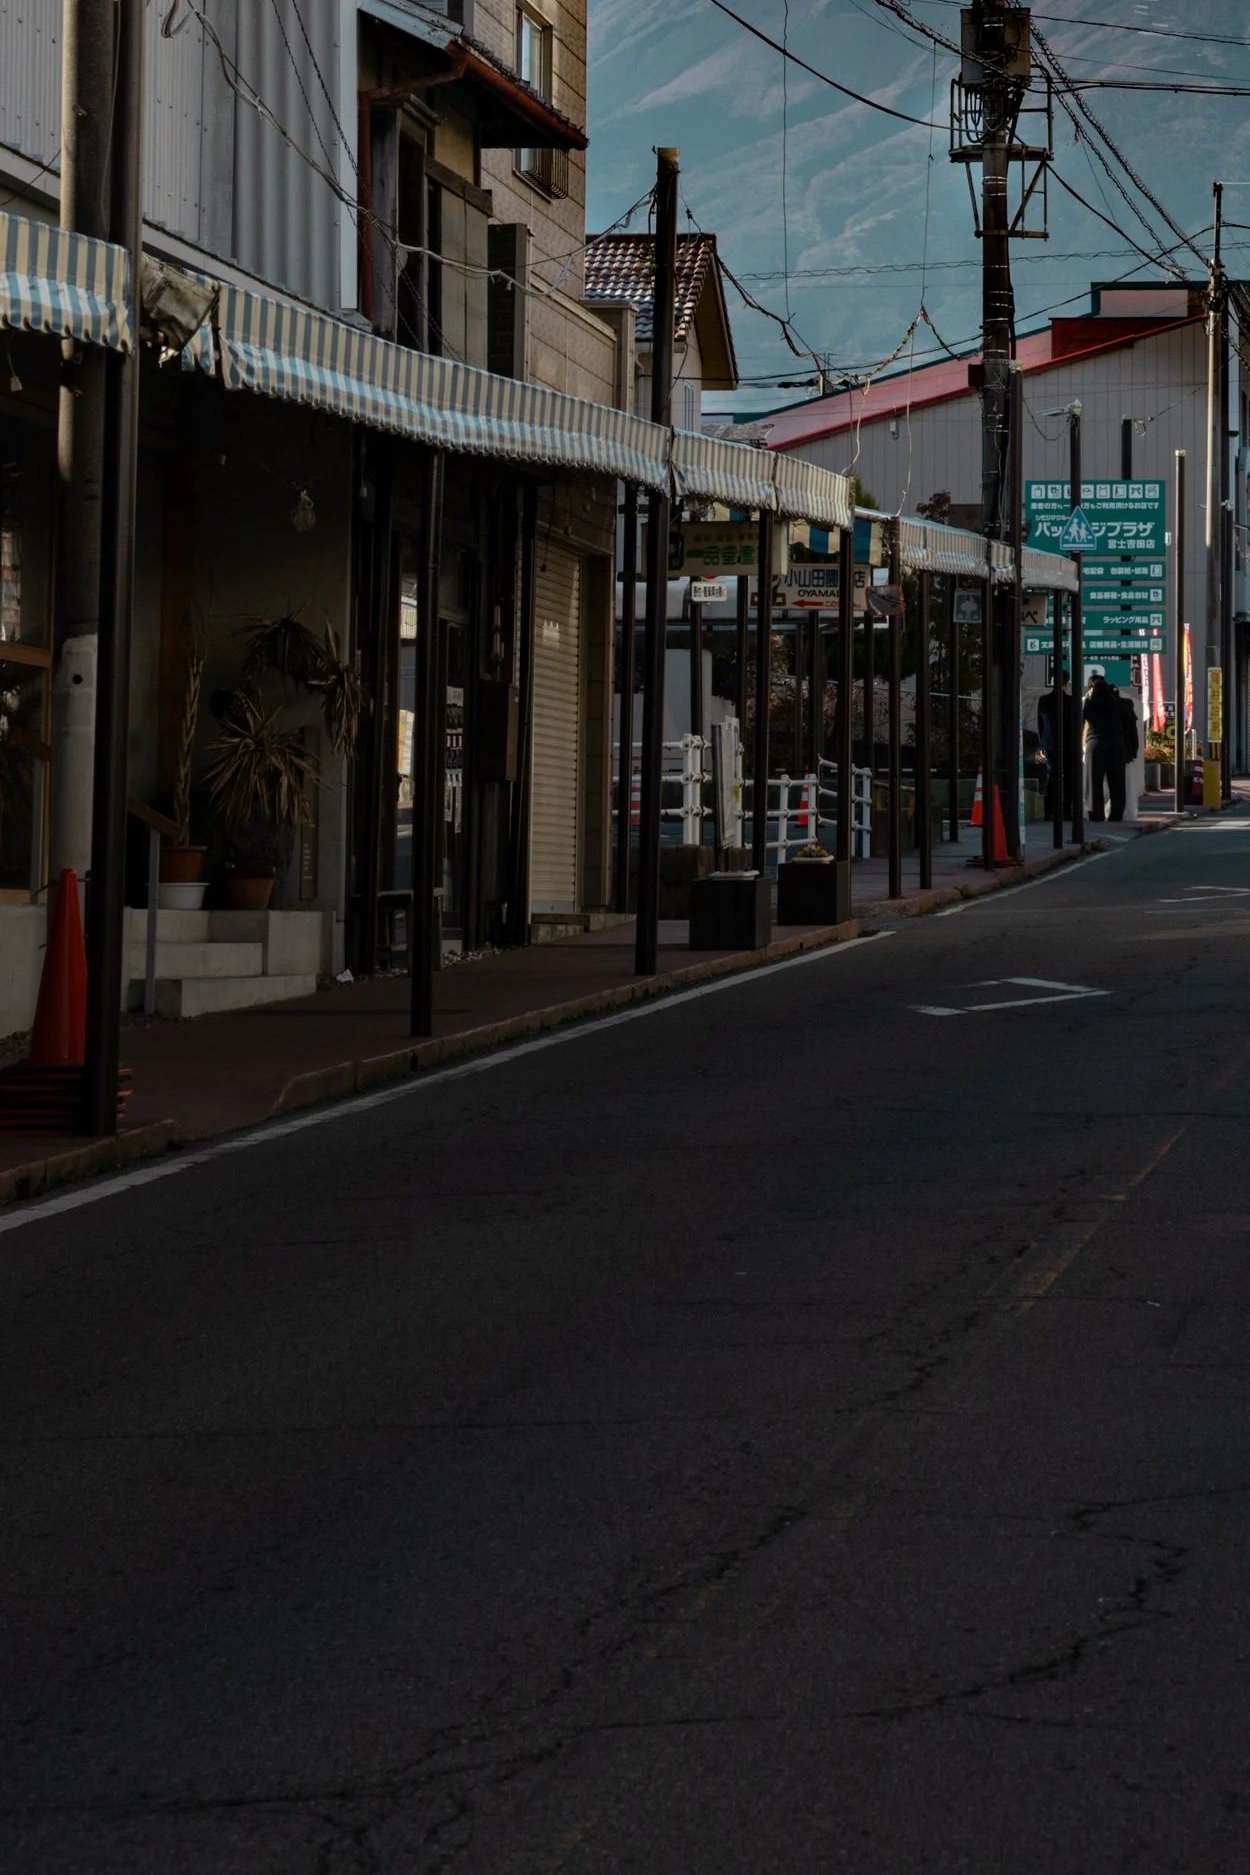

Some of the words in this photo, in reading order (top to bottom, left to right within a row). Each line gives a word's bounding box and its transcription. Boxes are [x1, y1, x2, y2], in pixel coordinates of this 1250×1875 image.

[1034, 521, 1155, 537] パッジプラザ
[1107, 539, 1155, 549] 富士吉田店
[1102, 616, 1148, 624] ラッピング用品
